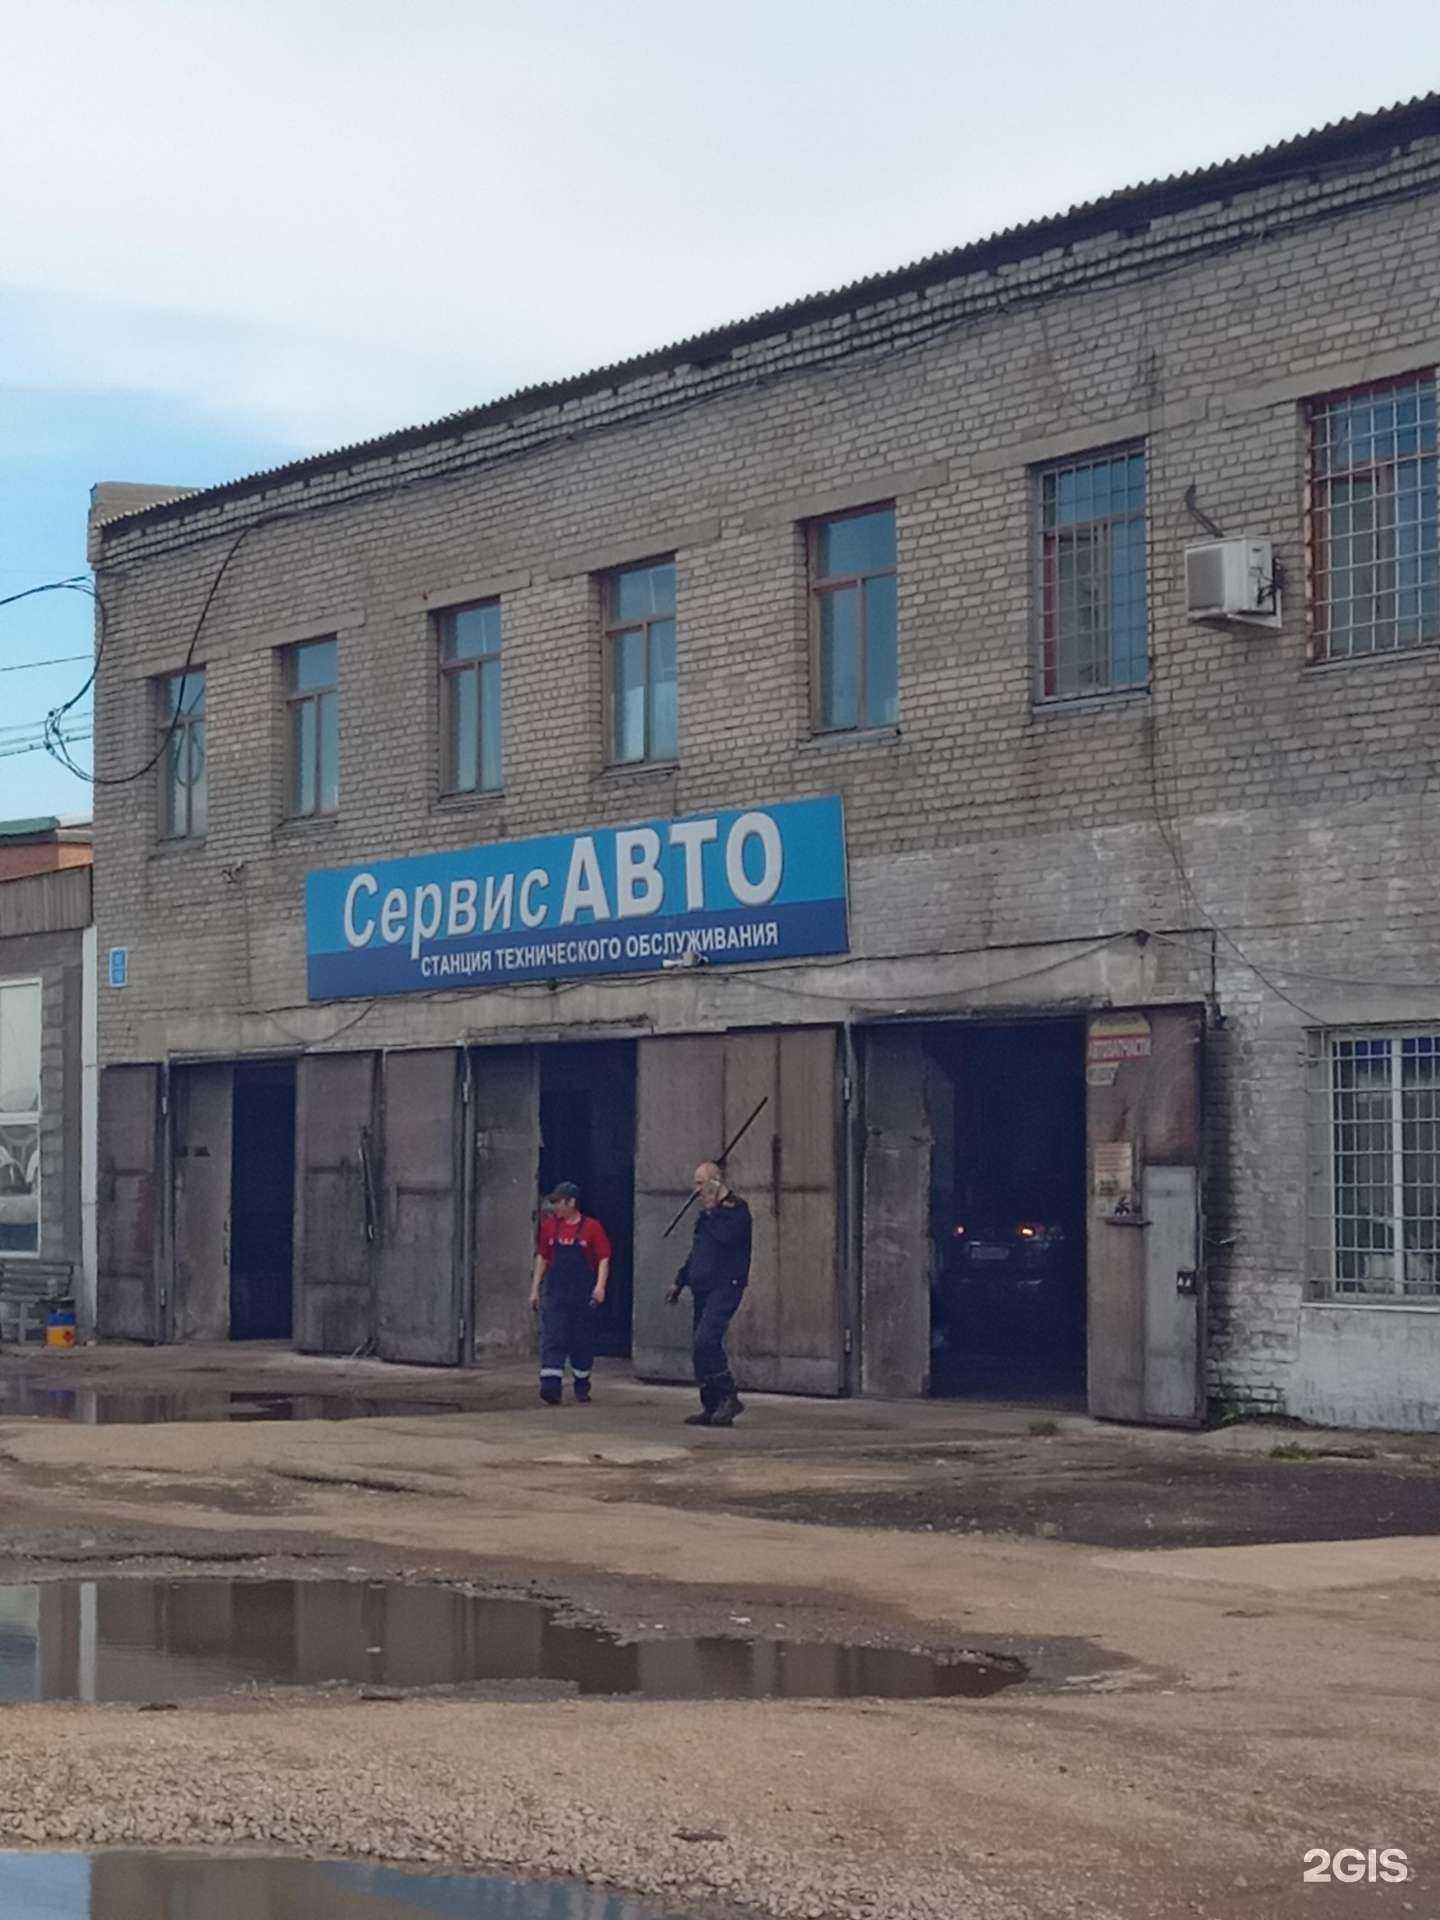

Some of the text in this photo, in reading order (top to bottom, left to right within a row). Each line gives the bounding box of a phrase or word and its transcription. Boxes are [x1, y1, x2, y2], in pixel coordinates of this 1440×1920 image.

[560, 811, 783, 924] АВТО
[421, 922, 778, 977] СТАНЦИЯ ТЕХНИЧЕСКОГО ОБСЛУЖИВАНИЯ
